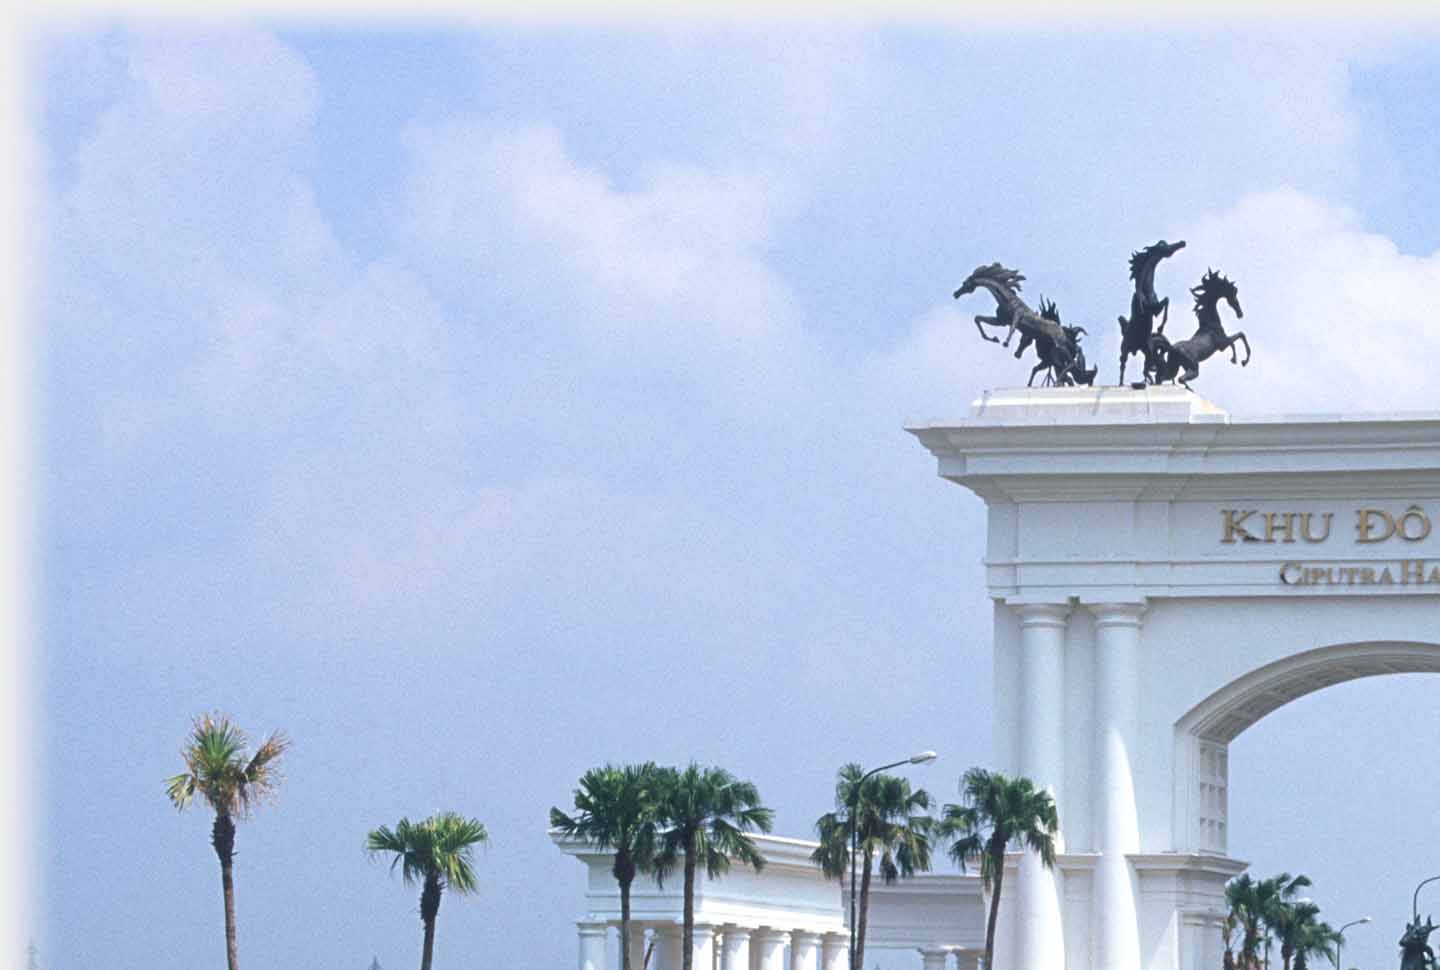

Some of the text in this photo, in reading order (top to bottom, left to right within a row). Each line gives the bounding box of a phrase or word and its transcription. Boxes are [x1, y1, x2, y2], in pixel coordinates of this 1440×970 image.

[1220, 509, 1334, 544] KHU
[1355, 504, 1431, 544] ĐÔ
[1279, 559, 1393, 585] CIPUTRA
